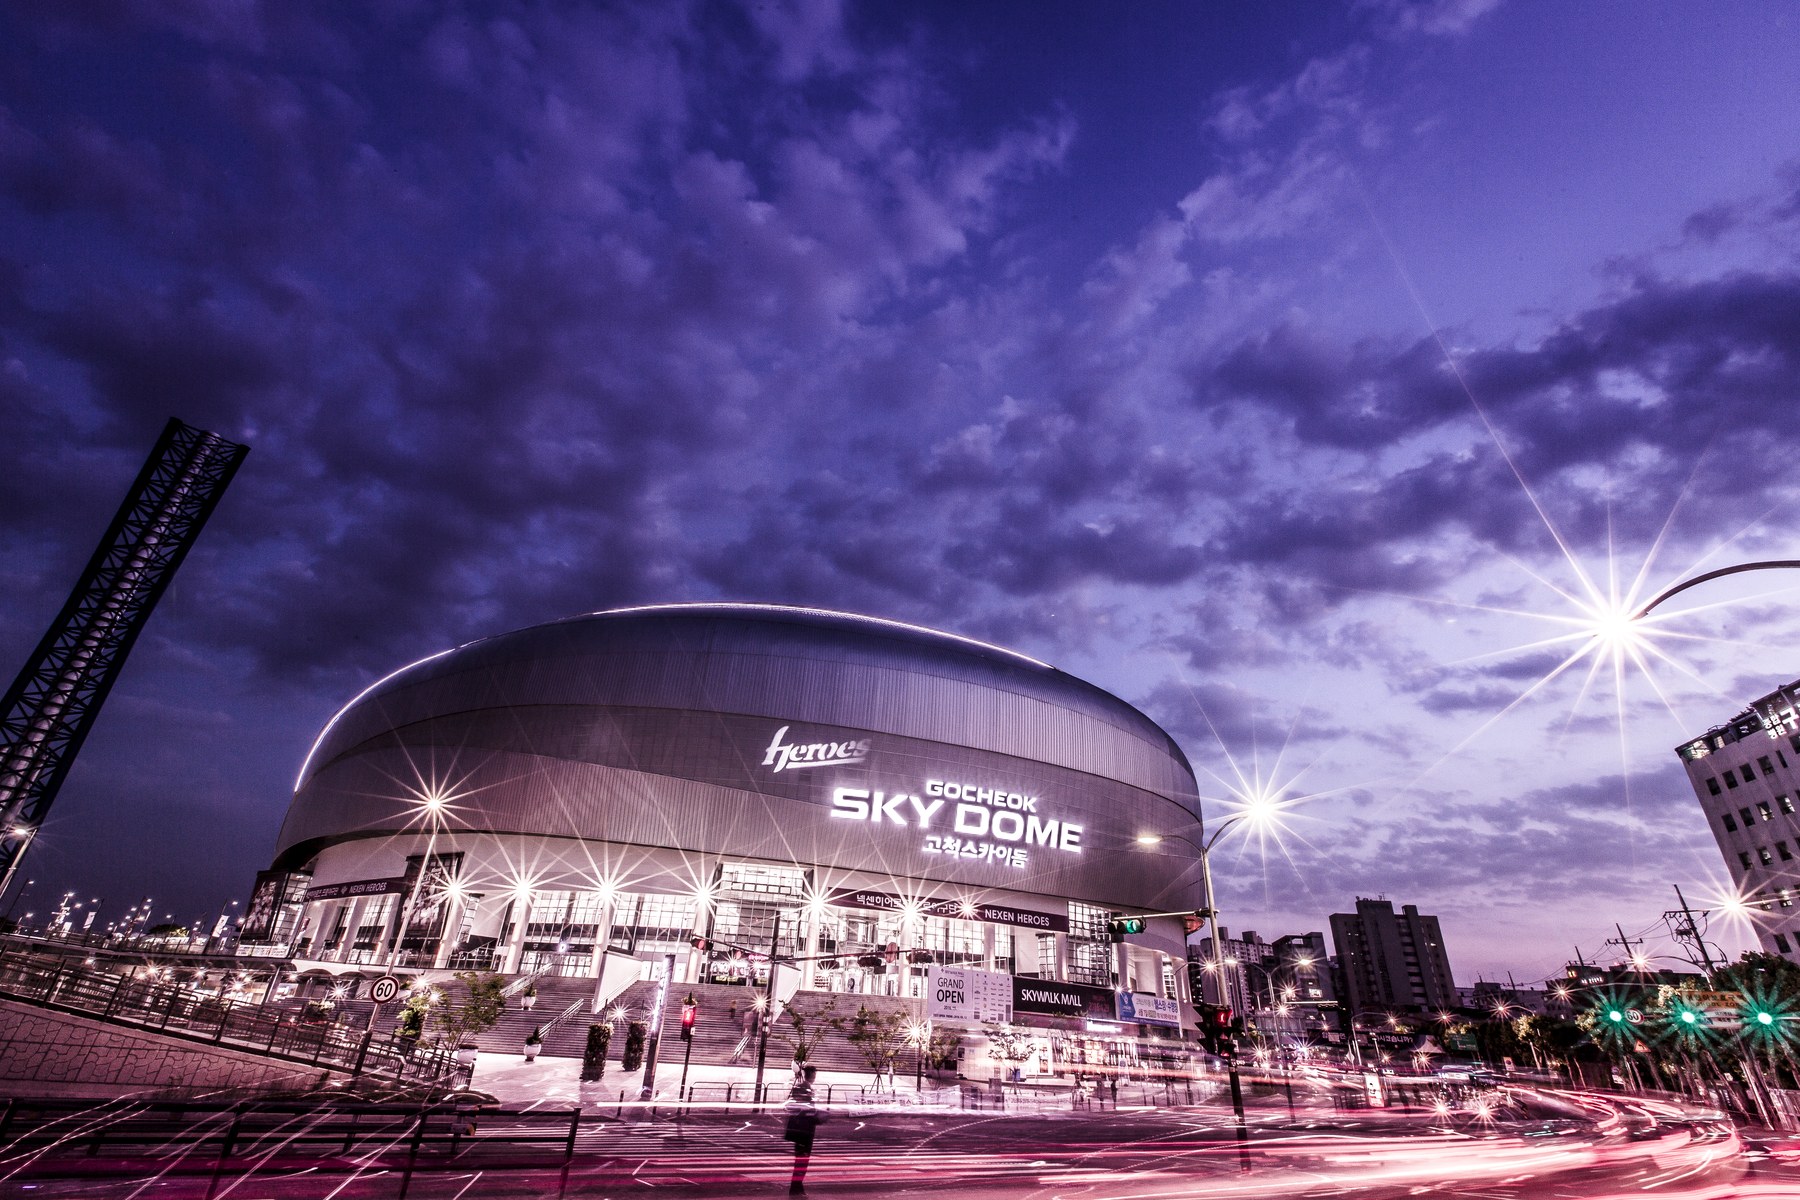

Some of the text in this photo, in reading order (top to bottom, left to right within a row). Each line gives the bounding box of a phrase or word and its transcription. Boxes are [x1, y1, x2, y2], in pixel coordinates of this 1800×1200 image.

[761, 725, 872, 773] heroes
[925, 779, 1038, 813] GOCHEOK
[830, 787, 1084, 854] SKY DOME
[921, 835, 1029, 869] 고척스카이돔
[856, 894, 909, 909] 넥센히어로
[985, 908, 1050, 927] NEXEN HEROES
[376, 982, 393, 998] 60
[937, 977, 965, 990] GRAND
[936, 989, 965, 1004] OPEN
[1021, 988, 1061, 1005] SKYWALK
[1061, 993, 1083, 1007] MALL
[1626, 1010, 1640, 1021] 60
